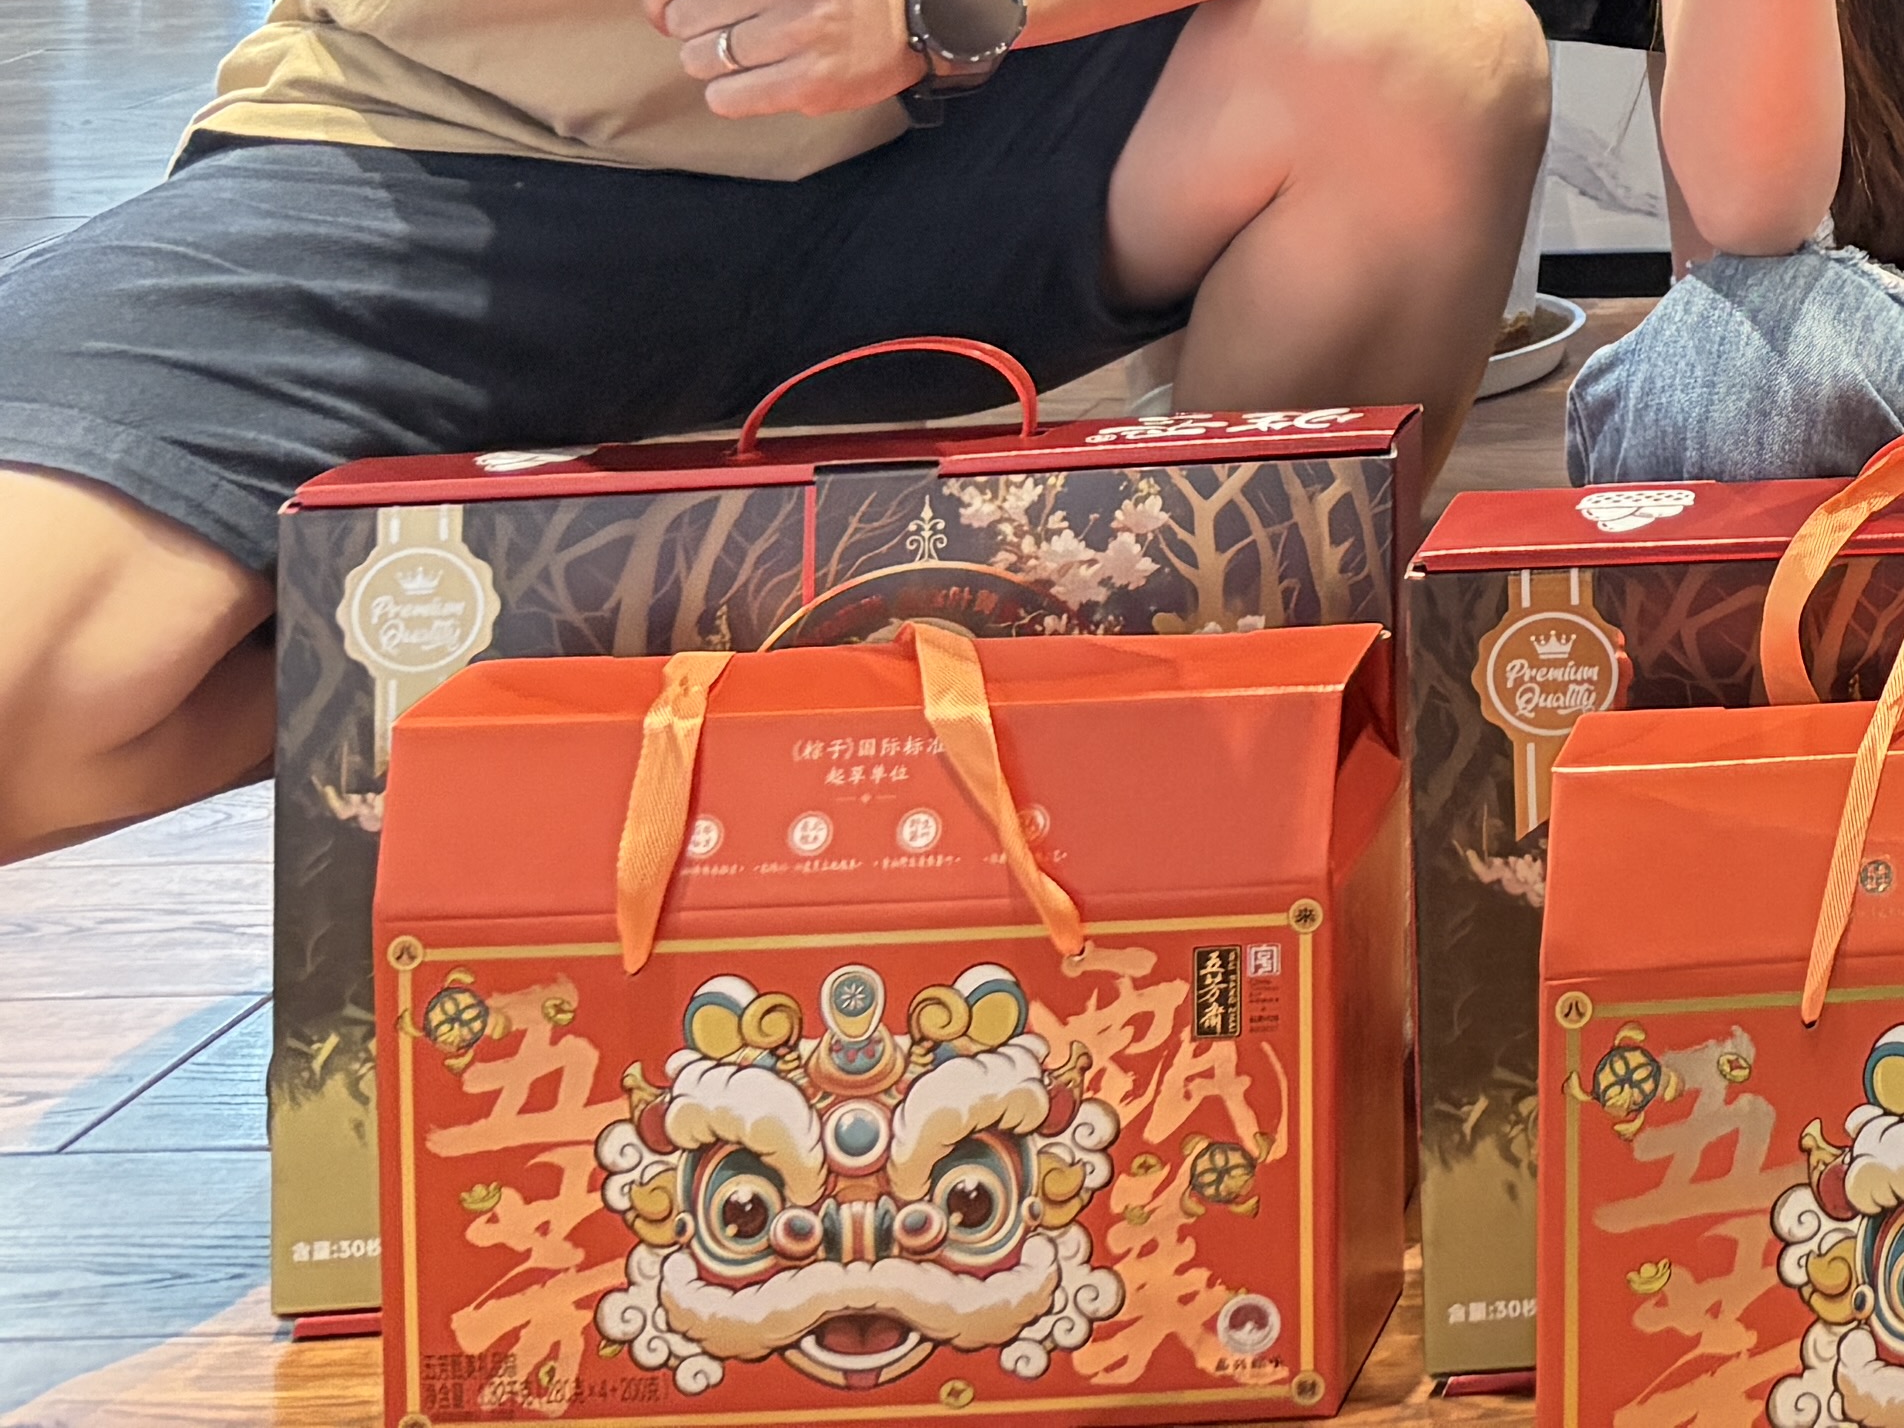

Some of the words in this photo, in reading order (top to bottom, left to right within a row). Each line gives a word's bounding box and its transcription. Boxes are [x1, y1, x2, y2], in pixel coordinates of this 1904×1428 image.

[370, 595, 466, 625] Premium
[378, 618, 461, 656] Quality
[1505, 658, 1599, 689] Premium
[1515, 682, 1597, 719] Quality
[1564, 1001, 1585, 1018] 八
